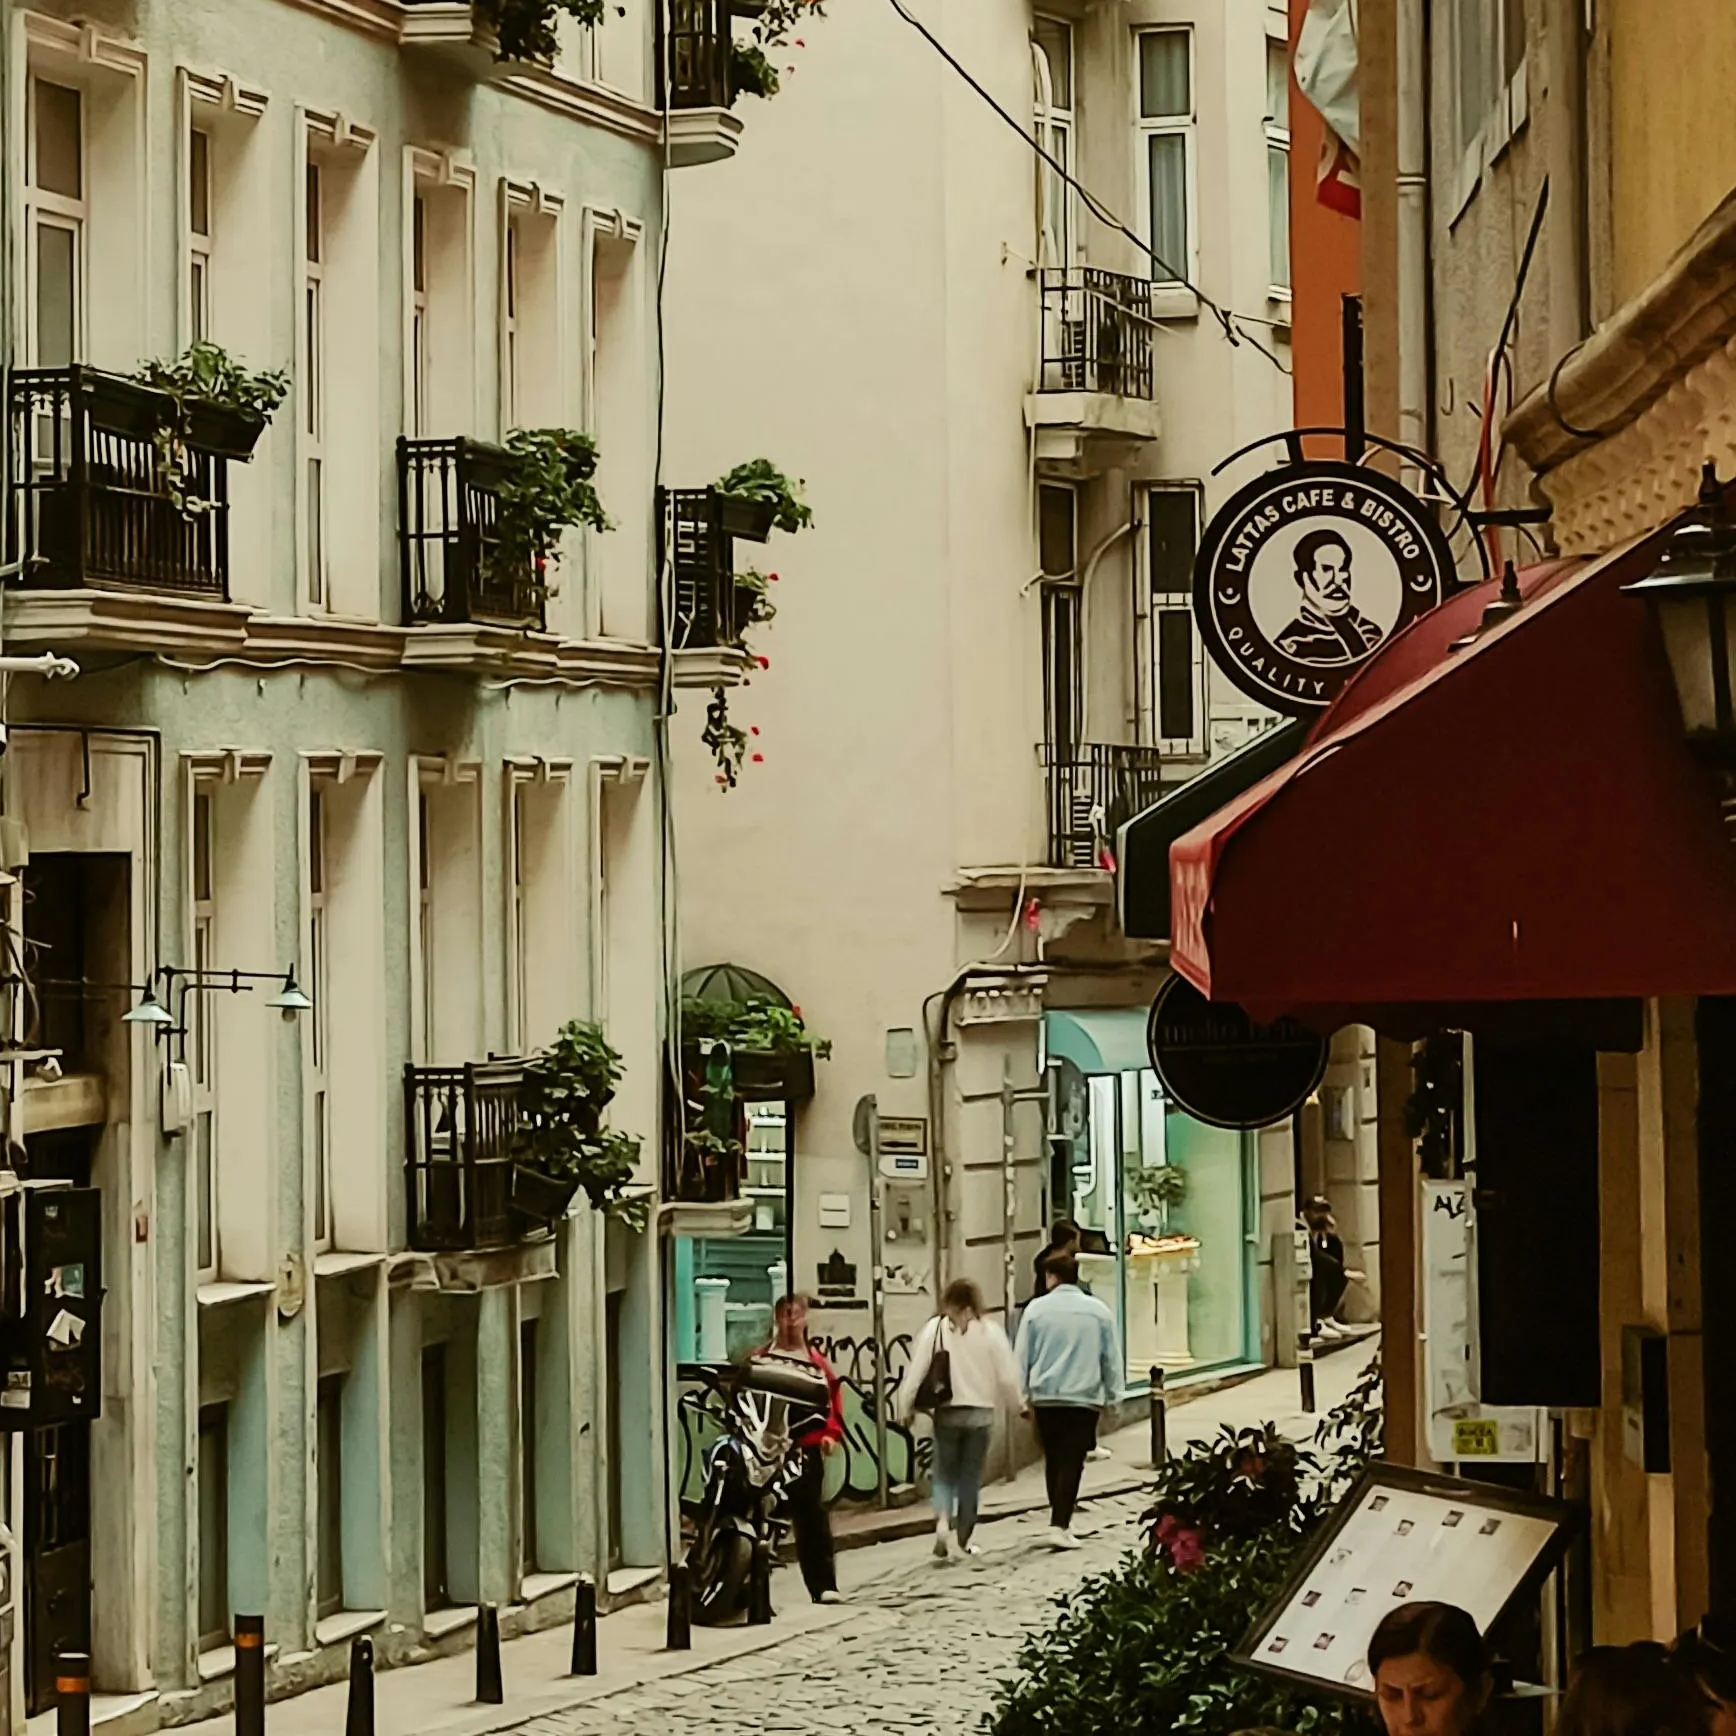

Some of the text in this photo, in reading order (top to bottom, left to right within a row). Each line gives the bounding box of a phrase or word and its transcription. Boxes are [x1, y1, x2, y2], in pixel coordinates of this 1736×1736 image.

[1226, 488, 1420, 572] LATTAS CAFE & BISTRO
[1228, 626, 1324, 695] QUALITY
